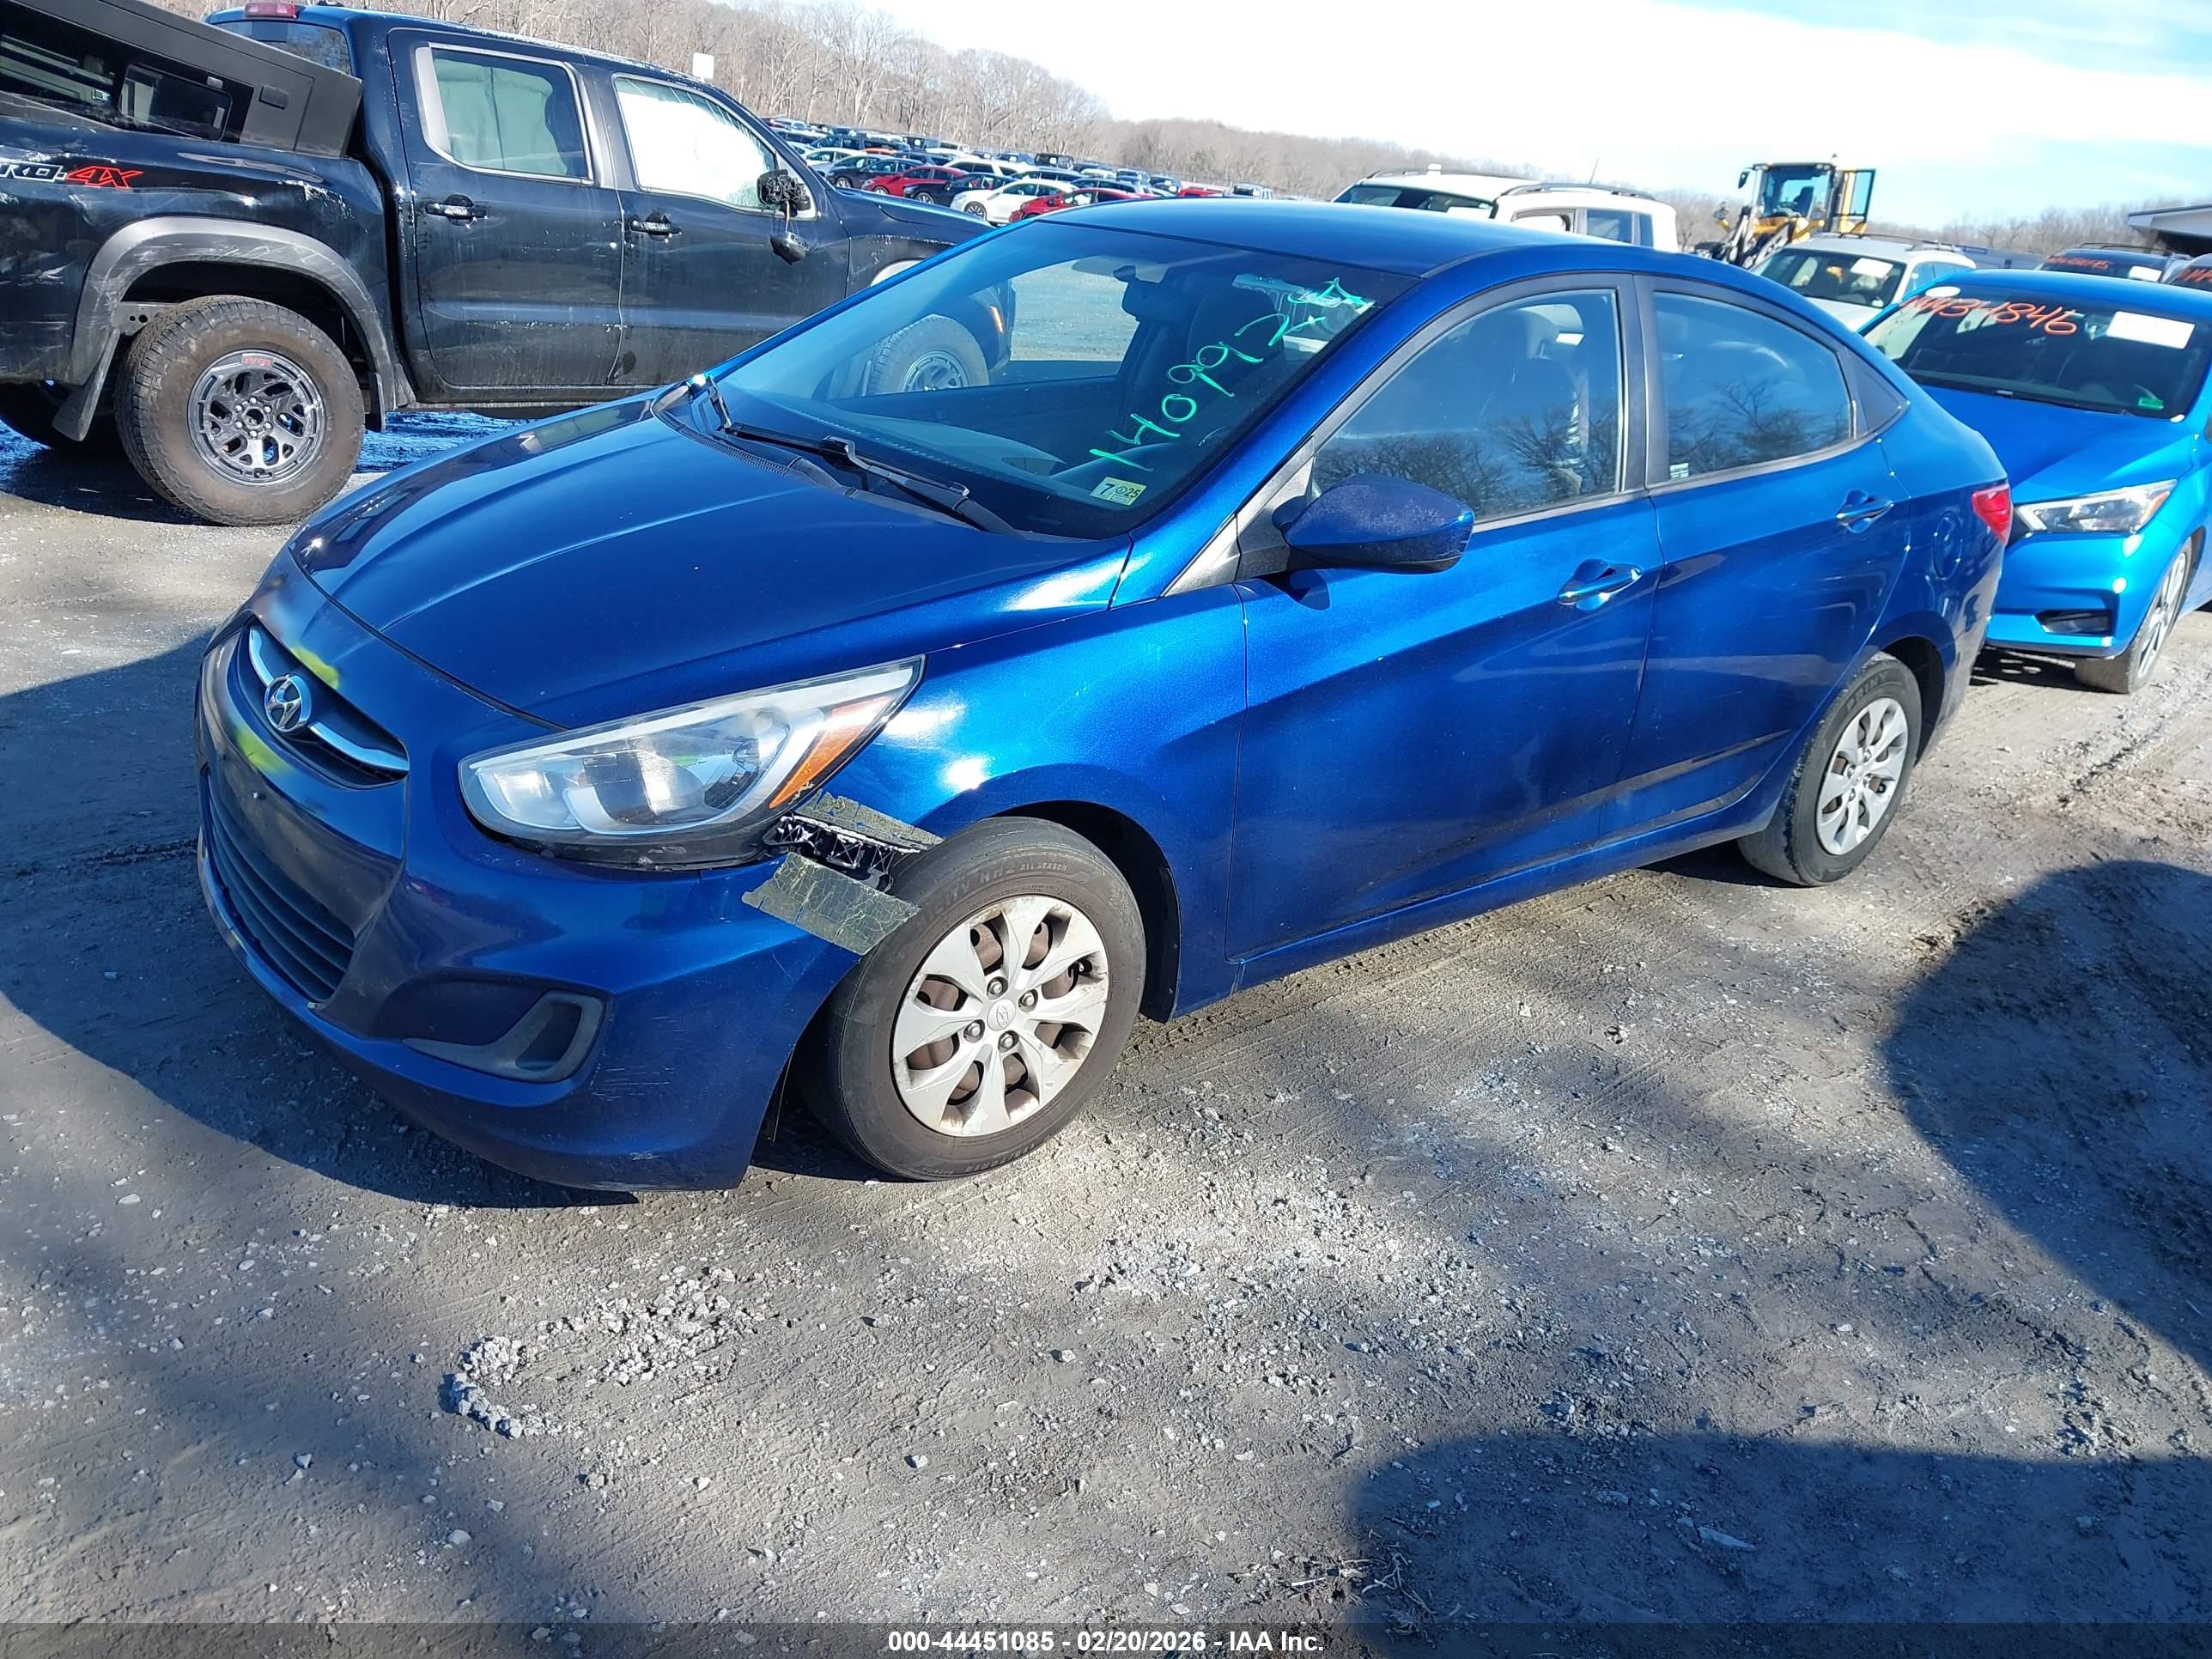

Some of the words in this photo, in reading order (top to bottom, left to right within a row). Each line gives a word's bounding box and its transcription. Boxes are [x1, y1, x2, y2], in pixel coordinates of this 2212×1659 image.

[1100, 483, 1115, 495] 7
[1125, 488, 1141, 499] 25
[1020, 863, 1035, 872] ALL
[1037, 862, 1068, 872] SEASON
